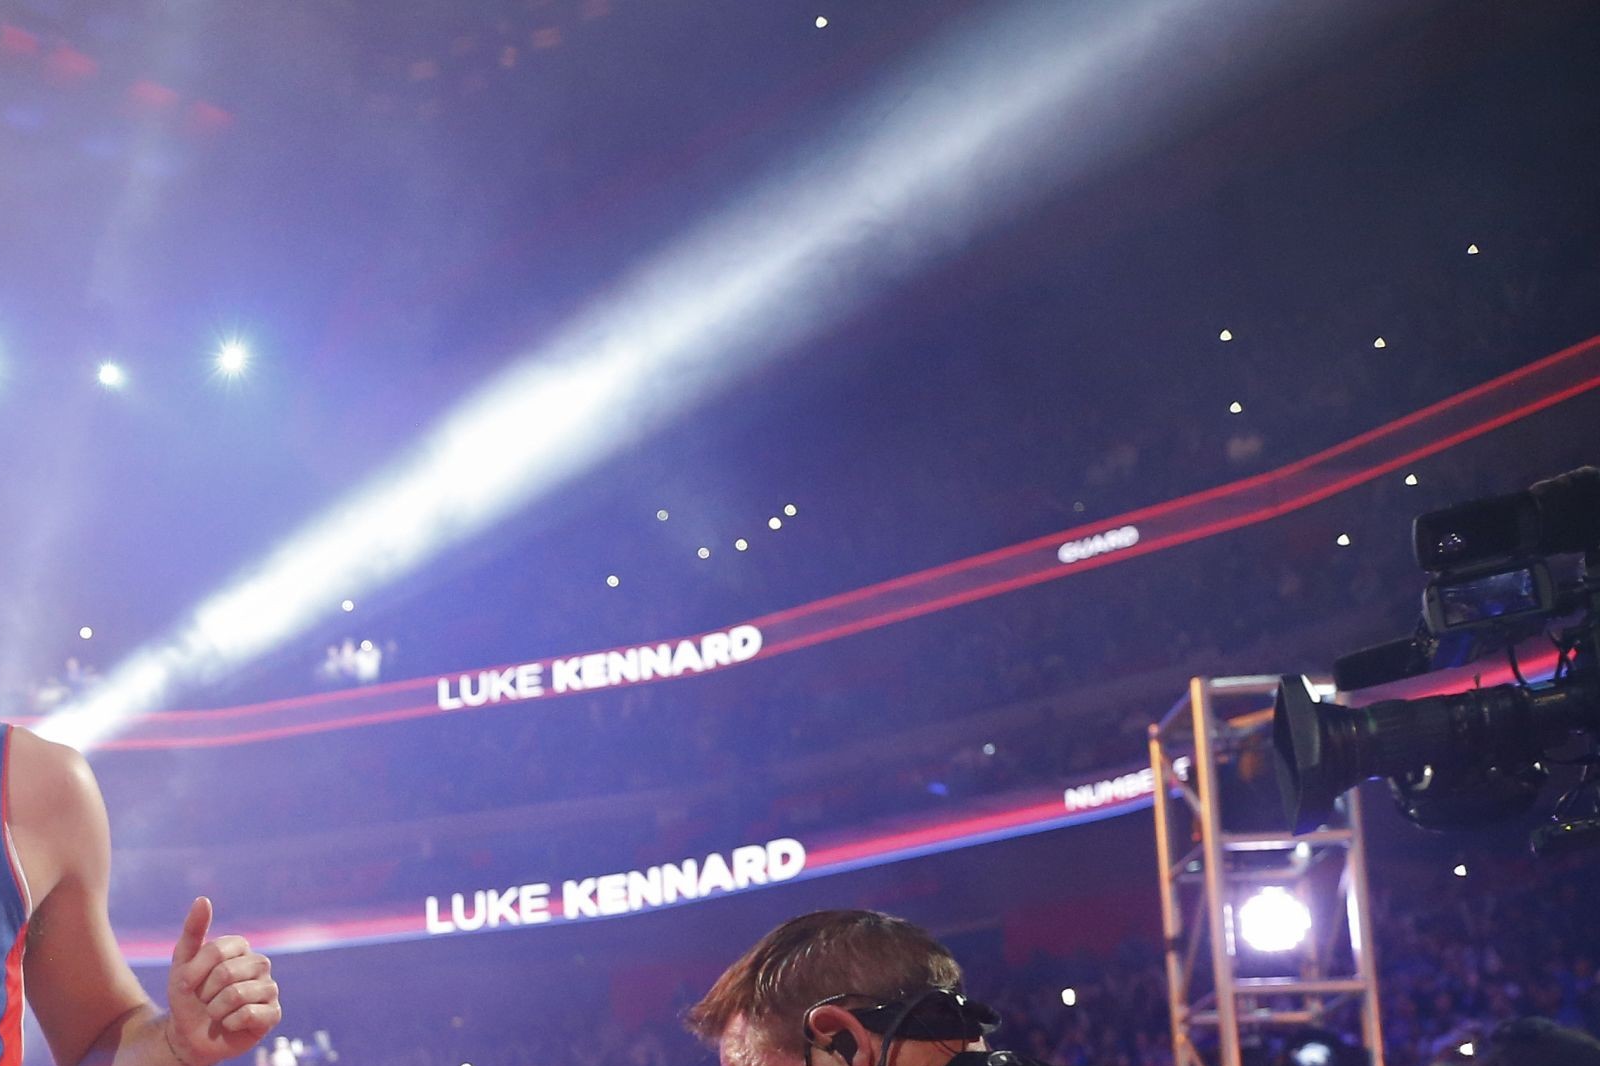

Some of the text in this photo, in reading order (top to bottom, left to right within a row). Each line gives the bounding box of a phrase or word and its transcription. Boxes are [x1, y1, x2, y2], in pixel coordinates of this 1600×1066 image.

[437, 625, 763, 710] LUKE KENNARD
[424, 838, 806, 935] LUKE KENNARD
